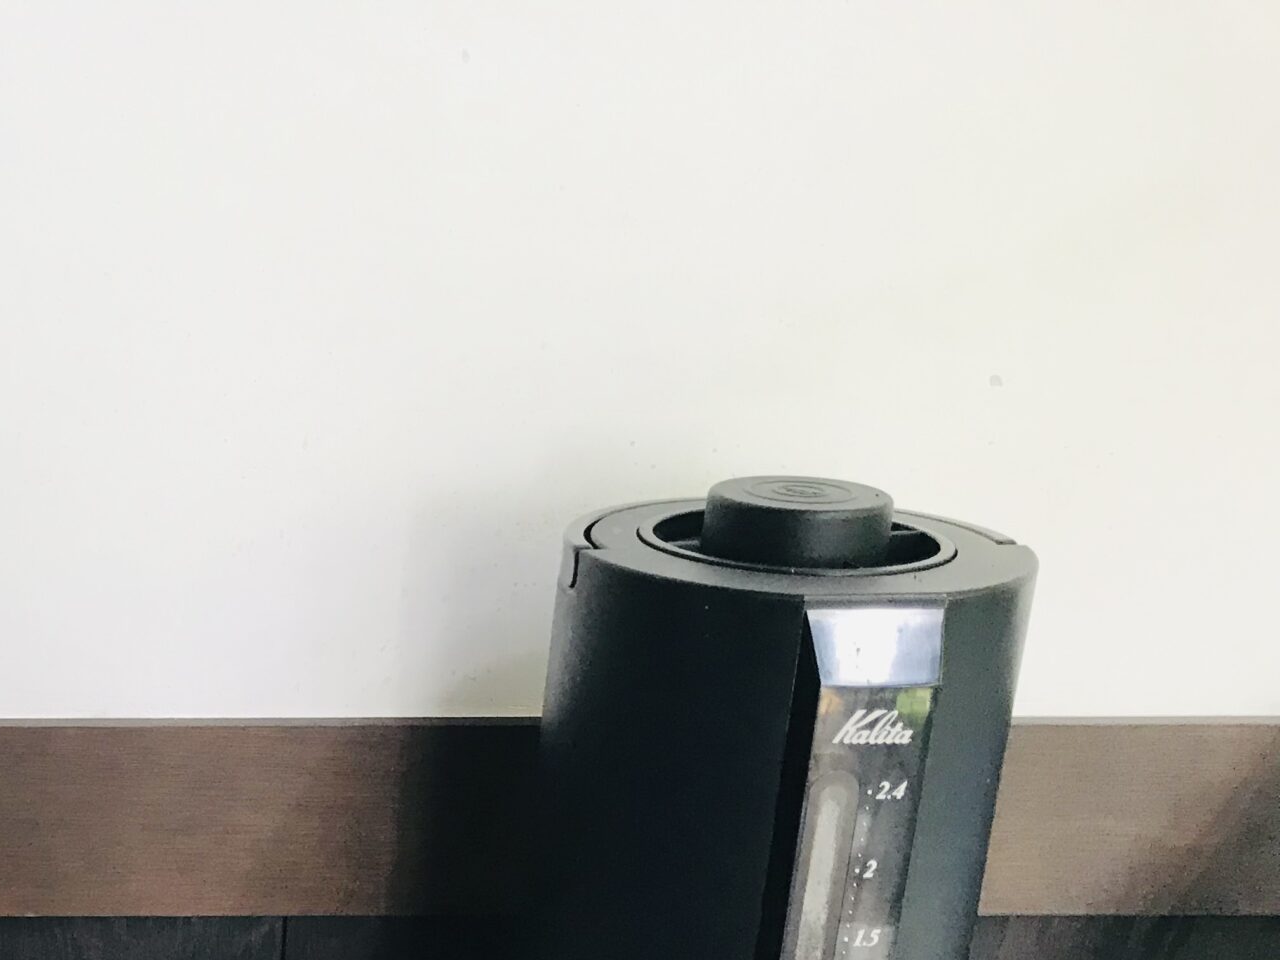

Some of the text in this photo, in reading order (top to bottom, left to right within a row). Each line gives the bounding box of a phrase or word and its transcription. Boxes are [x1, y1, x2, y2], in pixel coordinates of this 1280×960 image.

[832, 709, 913, 744] Kalita
[876, 781, 908, 800] 2.4
[863, 860, 878, 878] 2
[853, 929, 881, 947] 1.5
